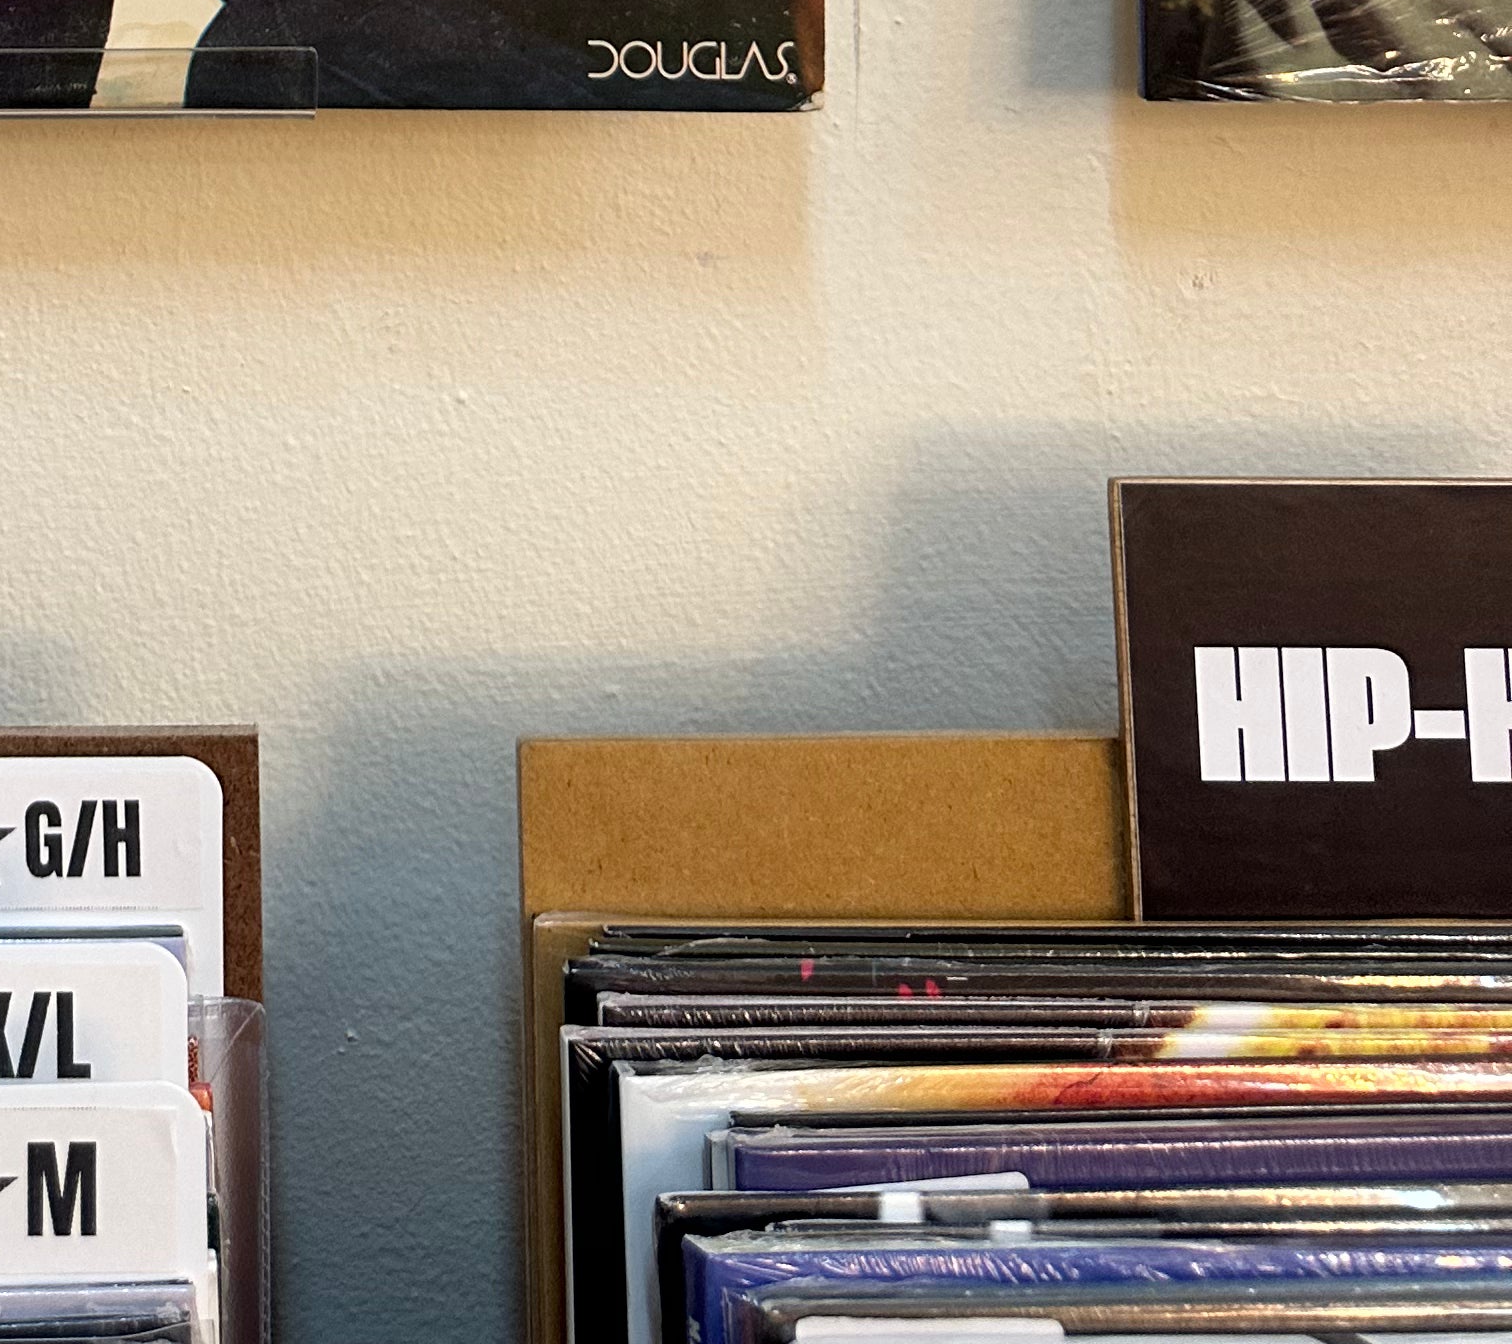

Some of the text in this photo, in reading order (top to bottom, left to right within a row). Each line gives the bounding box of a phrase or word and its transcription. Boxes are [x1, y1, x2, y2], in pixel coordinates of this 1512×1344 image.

[587, 40, 795, 80] DOUGLAS
[23, 798, 143, 880] G/H
[25, 1140, 98, 1237] M
